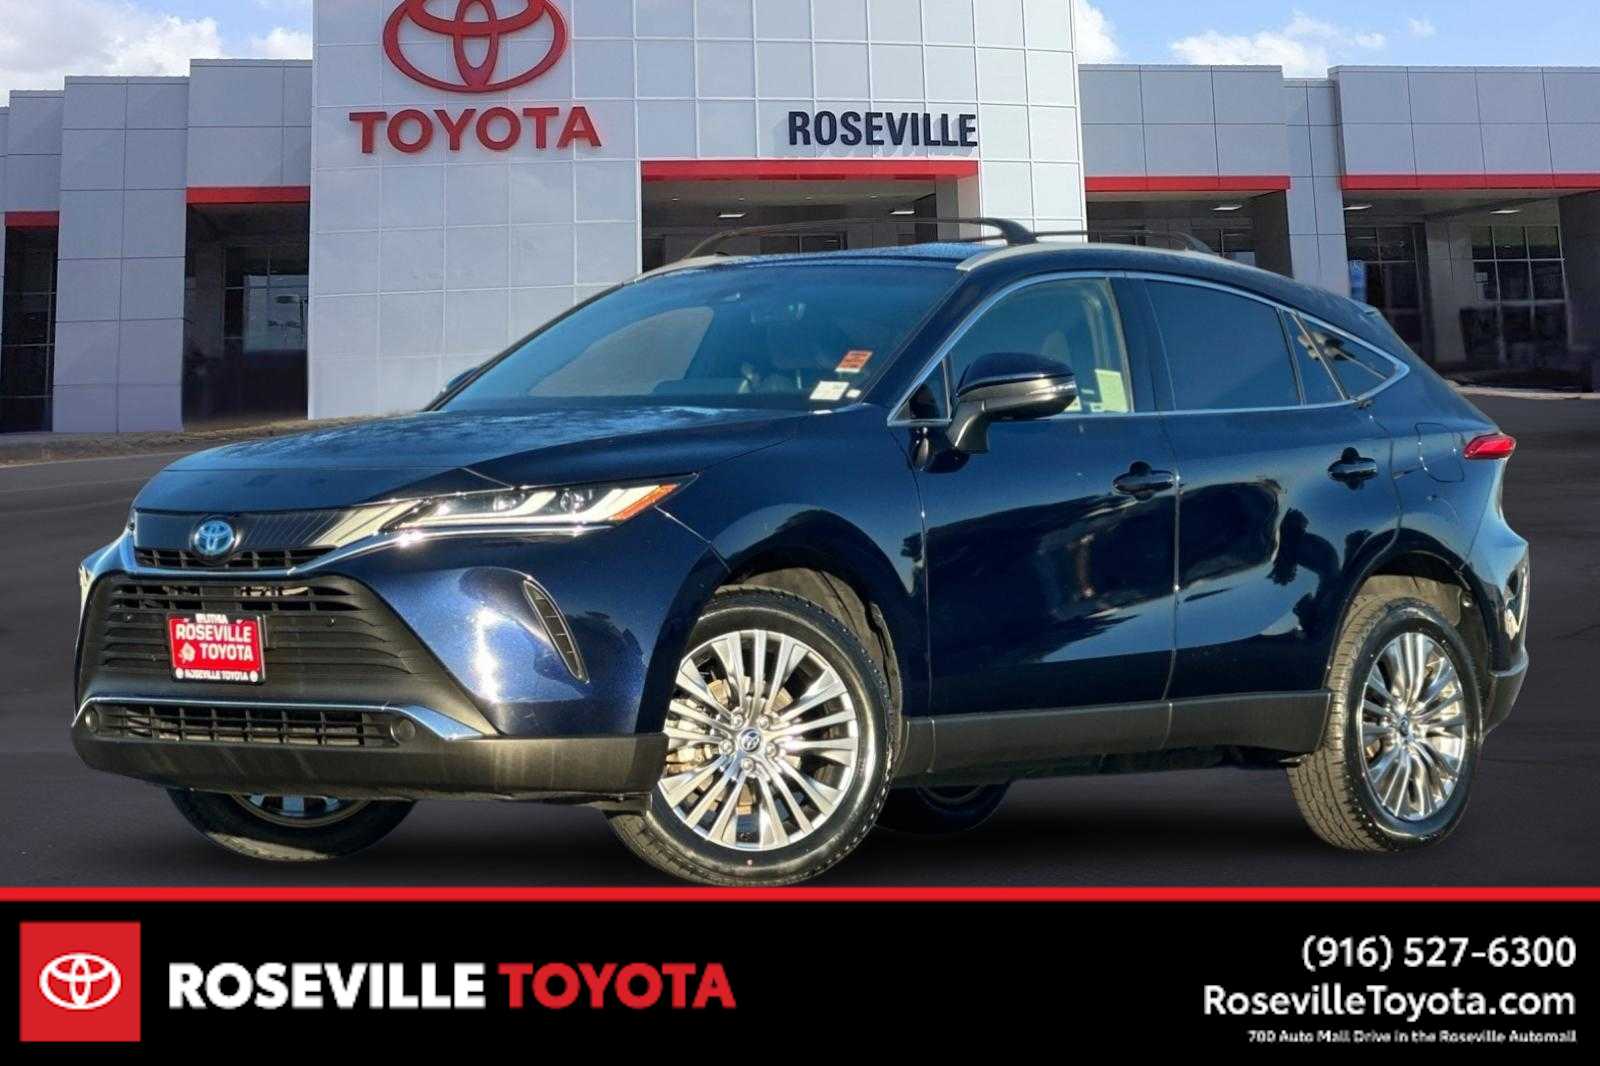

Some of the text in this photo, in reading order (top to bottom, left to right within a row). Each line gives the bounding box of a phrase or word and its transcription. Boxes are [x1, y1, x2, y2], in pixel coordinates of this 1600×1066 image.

[349, 106, 602, 153] TOYOTA
[788, 110, 978, 147] ROSEVILLE
[175, 624, 252, 643] ROSEVILLE
[199, 643, 254, 662] TOYOTA
